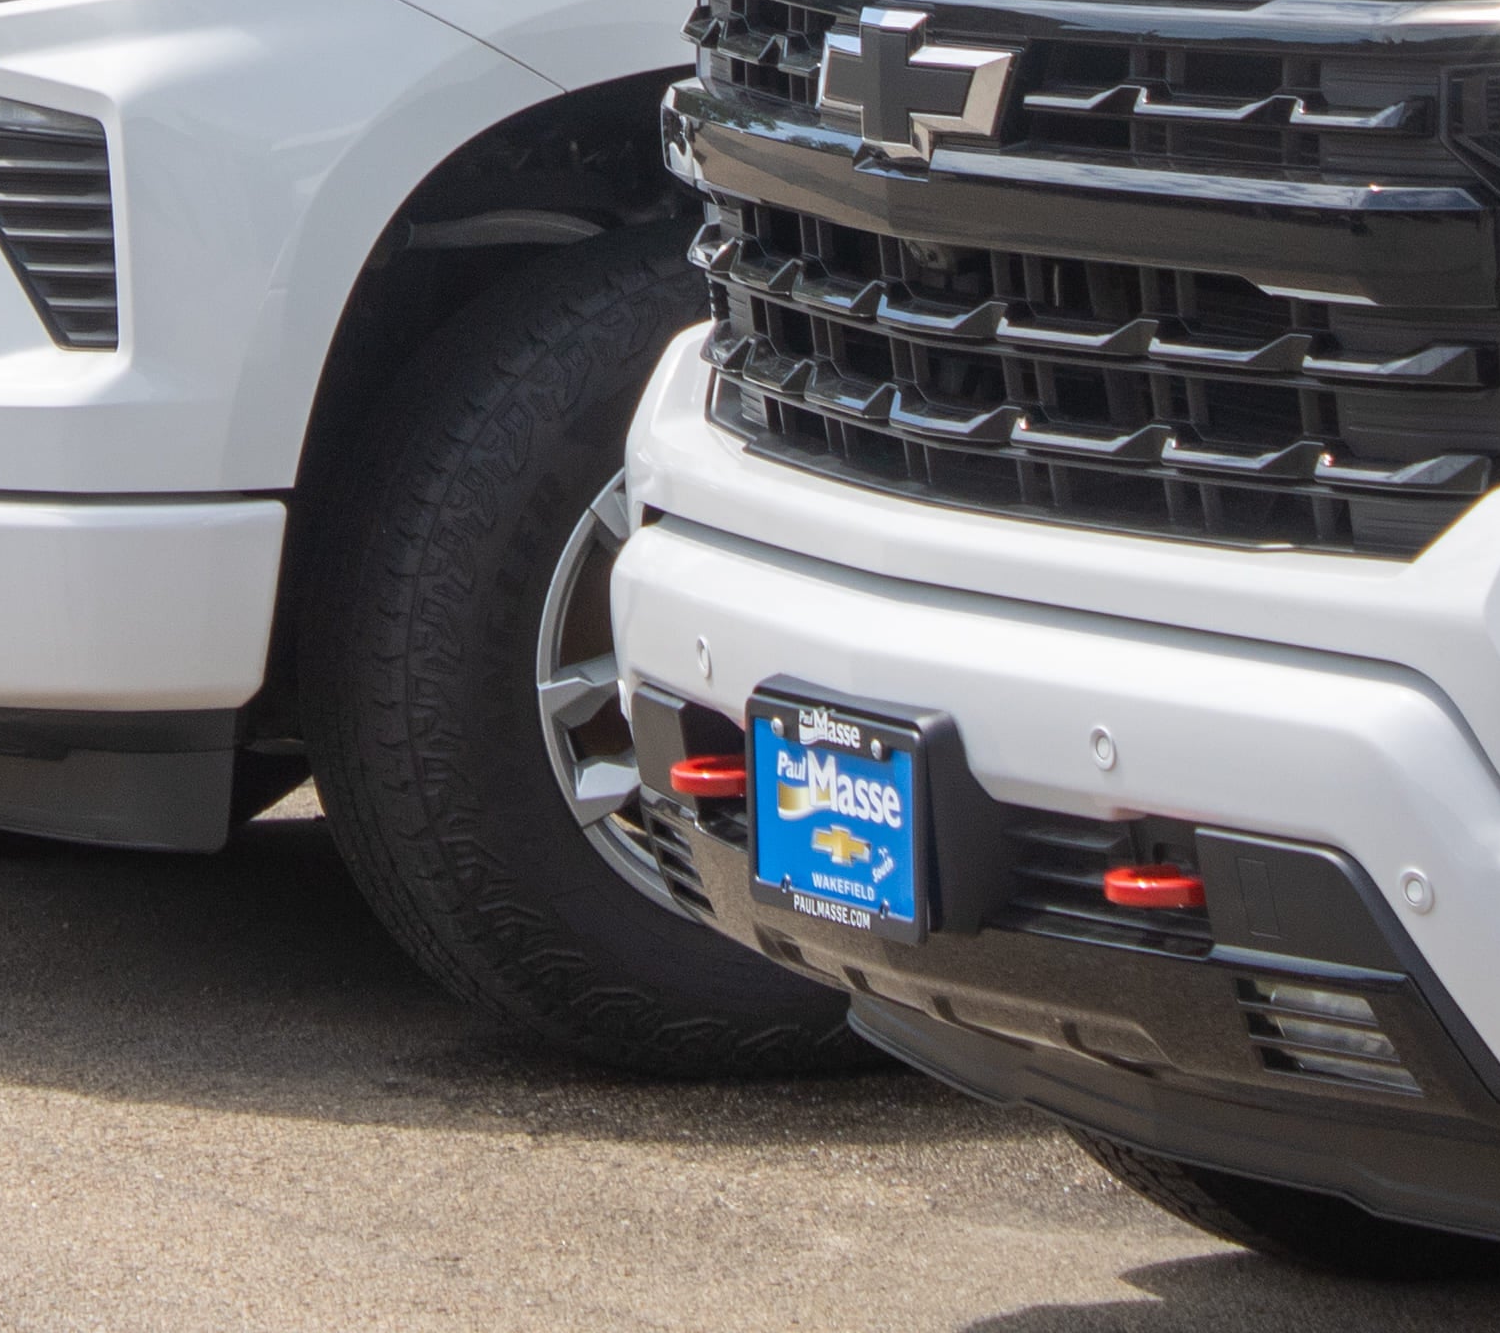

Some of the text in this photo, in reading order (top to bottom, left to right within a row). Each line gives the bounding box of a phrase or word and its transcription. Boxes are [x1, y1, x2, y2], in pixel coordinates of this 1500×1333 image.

[813, 708, 860, 748] Masse
[777, 749, 901, 828] Paul Masse
[811, 871, 875, 902] WAKEFIELD
[793, 894, 871, 930] PAULMASSE.COM
